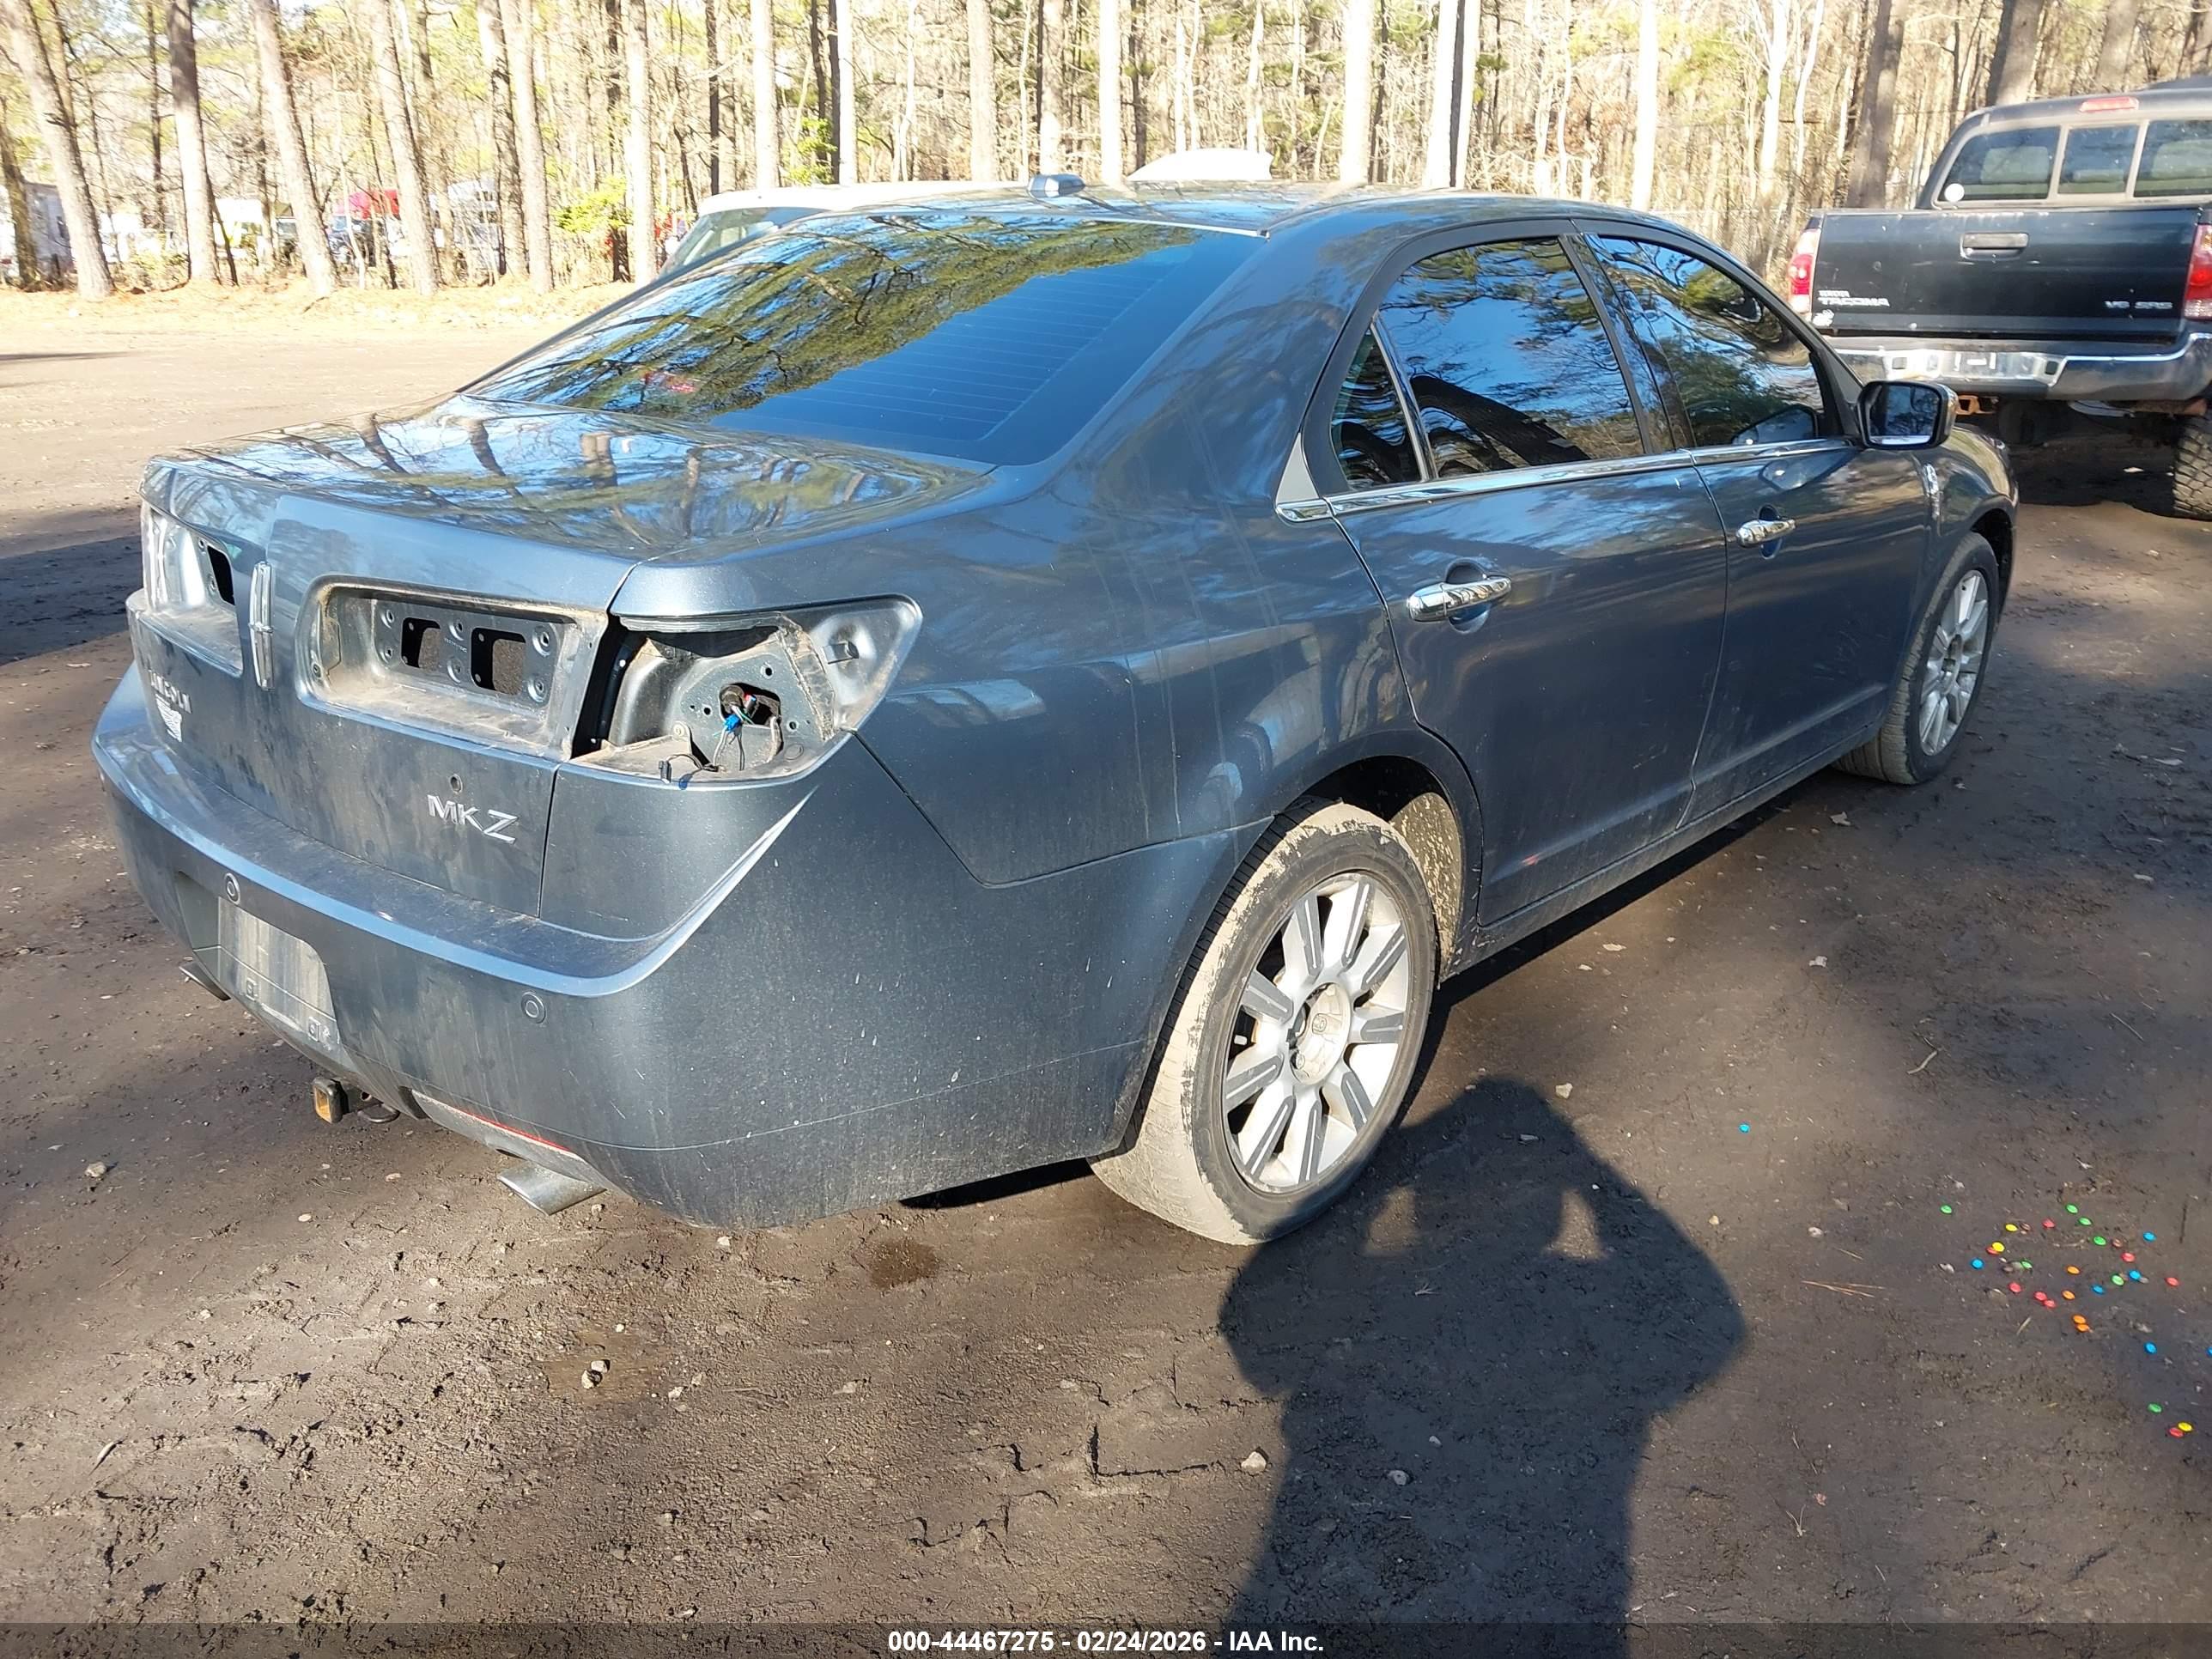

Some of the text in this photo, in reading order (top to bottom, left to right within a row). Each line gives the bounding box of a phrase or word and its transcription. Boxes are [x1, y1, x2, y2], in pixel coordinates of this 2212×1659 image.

[1817, 296, 1890, 307] TACOMA
[148, 669, 192, 714] LINCOLN
[427, 793, 519, 844] MKZ
